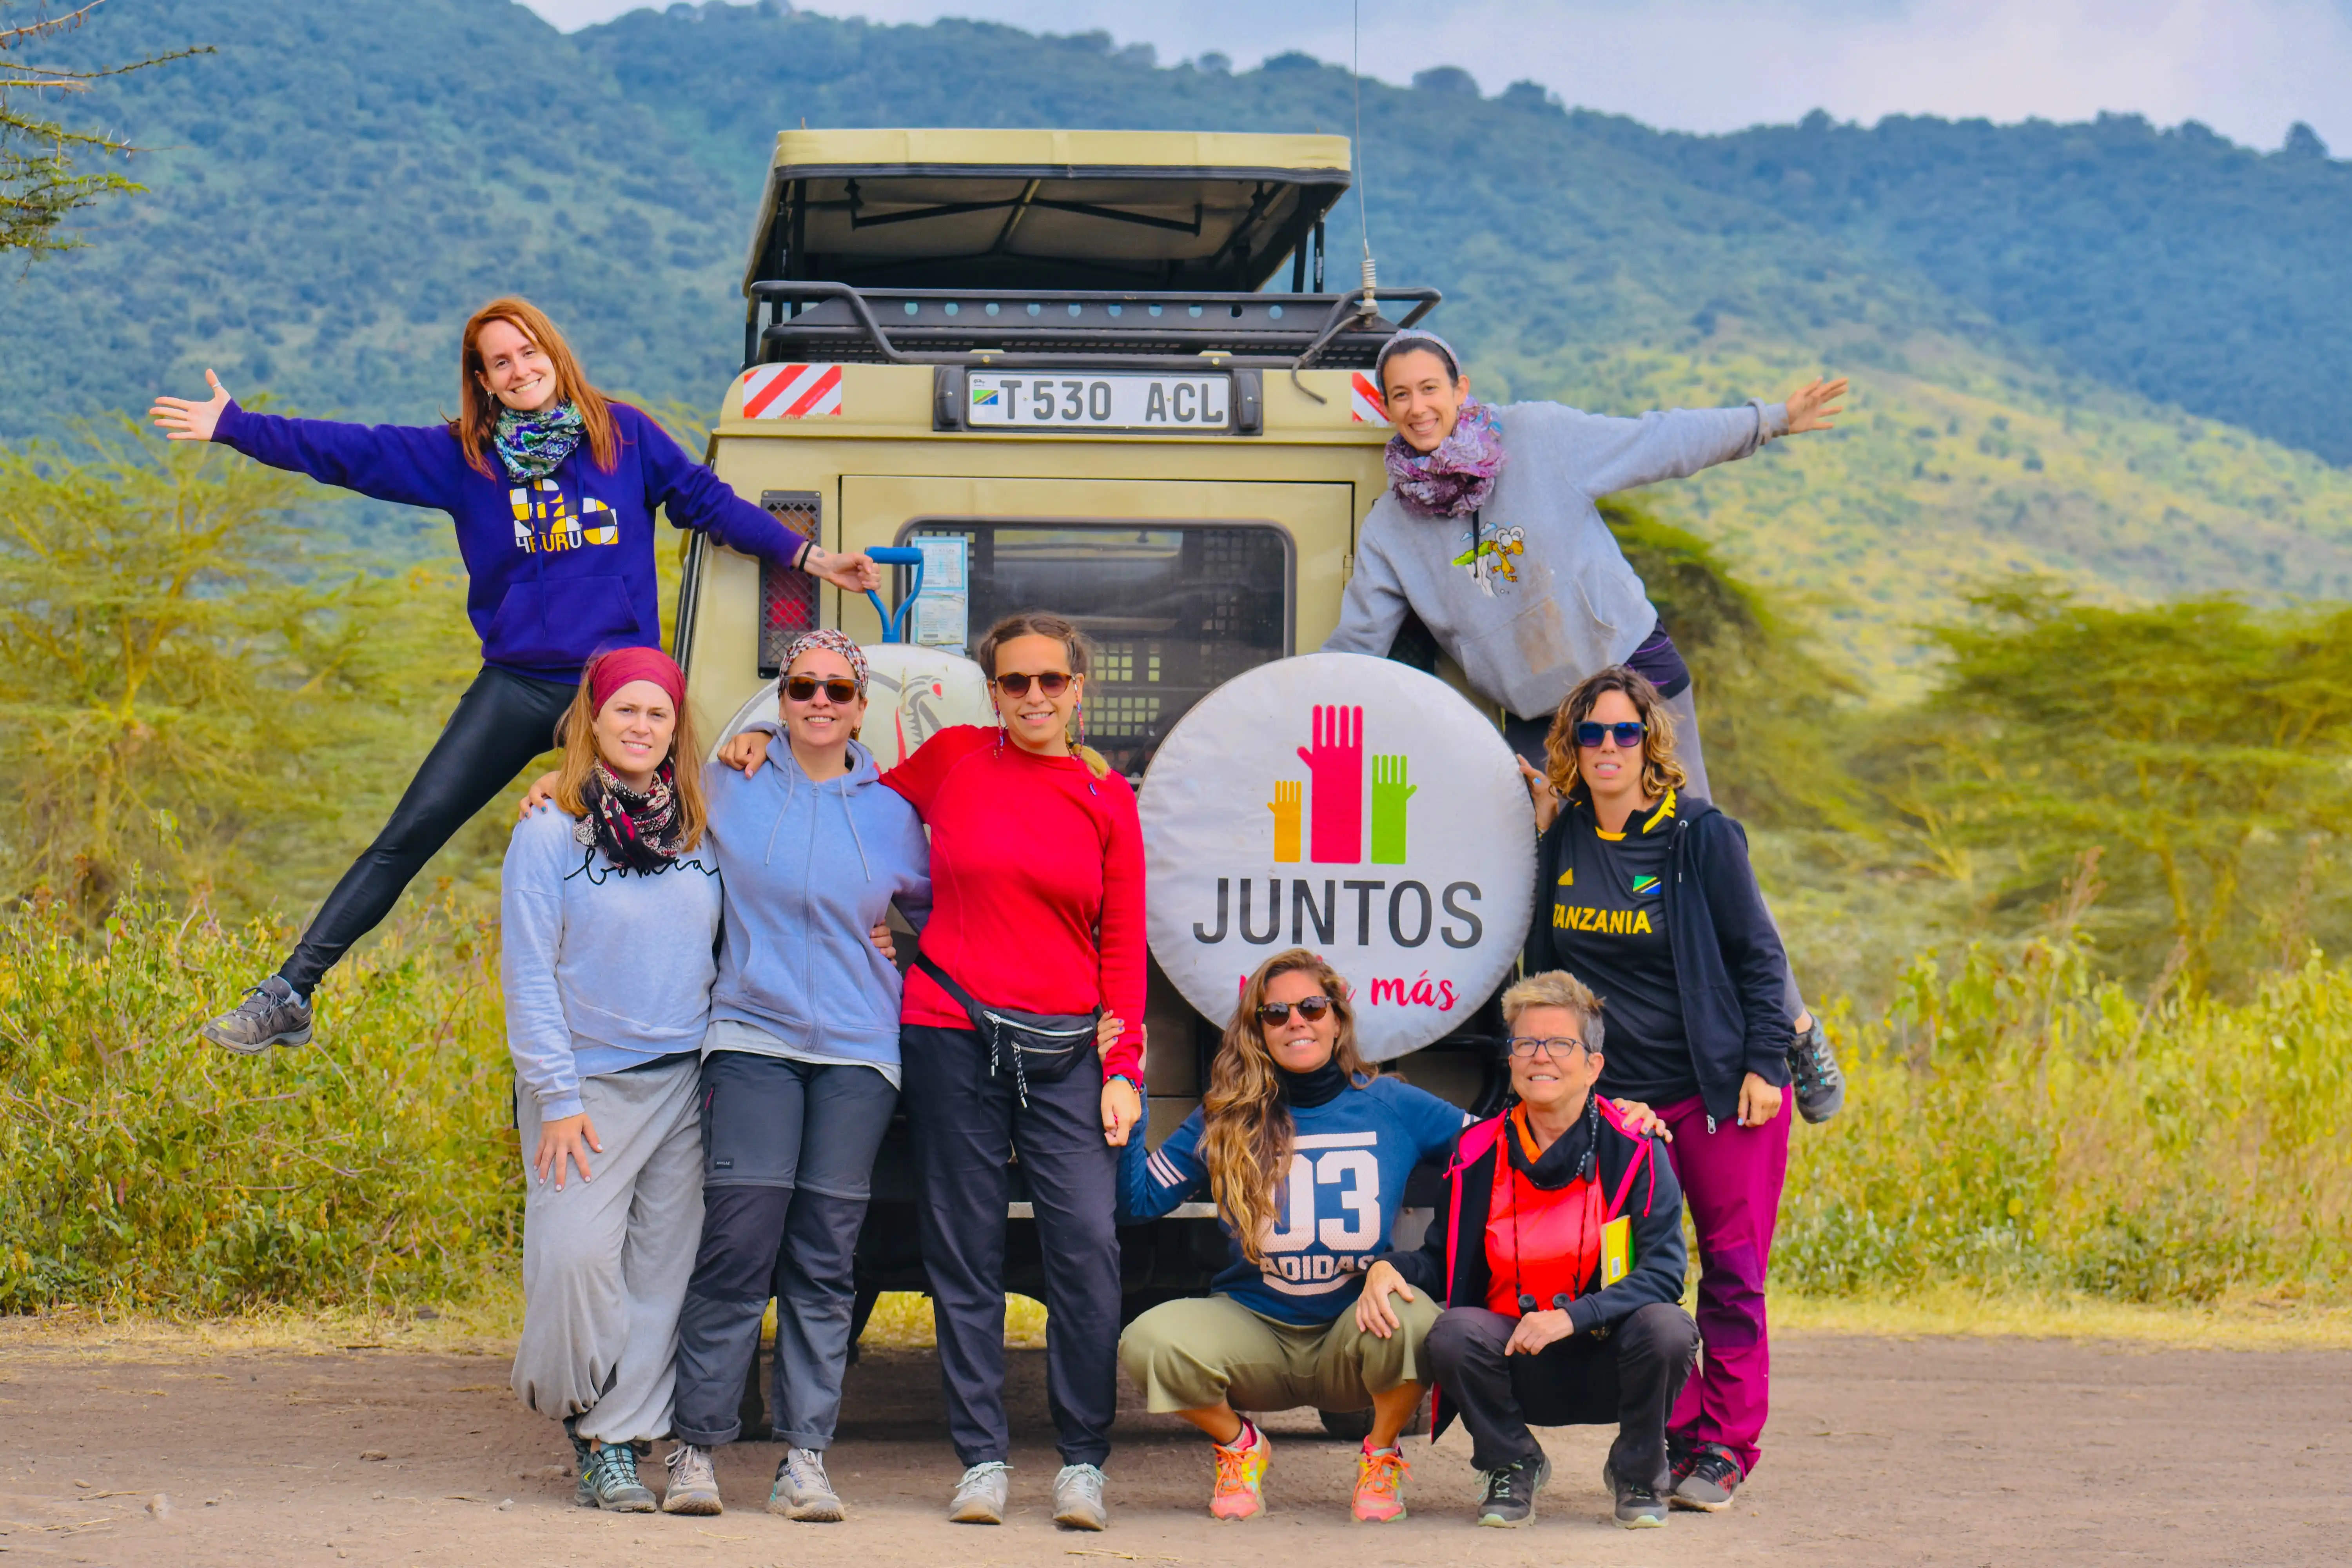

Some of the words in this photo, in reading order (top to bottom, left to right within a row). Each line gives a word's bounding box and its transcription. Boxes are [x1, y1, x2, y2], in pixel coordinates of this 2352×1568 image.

[1145, 383, 1223, 423] ACL
[1193, 878, 1483, 949] JUNTOS
[1553, 903, 1652, 935] TANZANIA
[1370, 969, 1461, 1012] más
